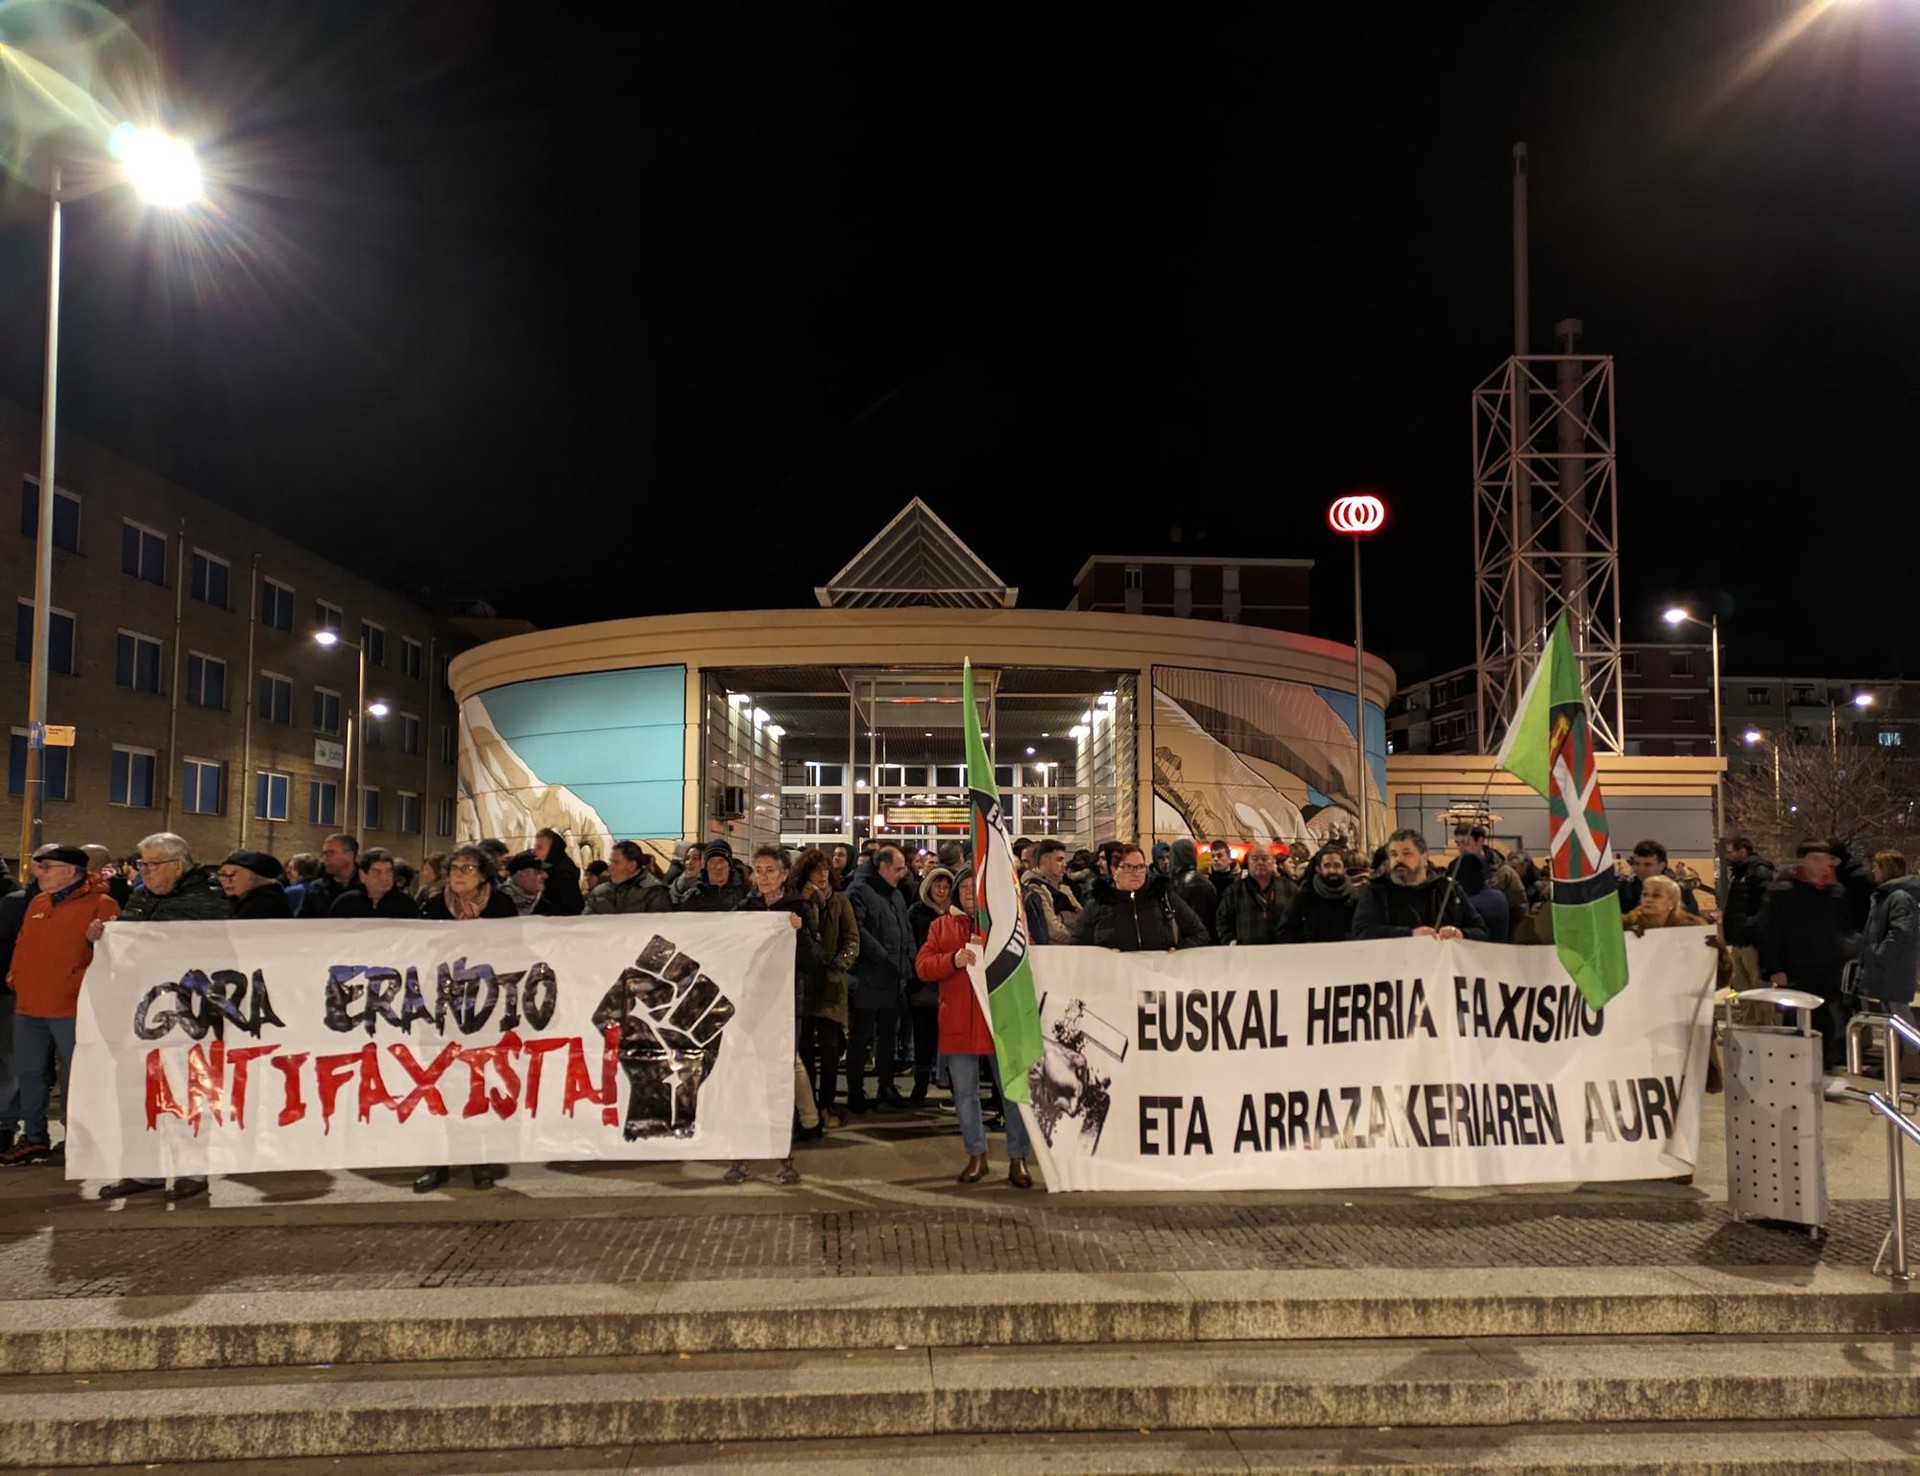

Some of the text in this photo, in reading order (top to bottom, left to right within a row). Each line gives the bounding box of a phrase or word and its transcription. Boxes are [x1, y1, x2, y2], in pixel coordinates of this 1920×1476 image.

[134, 957, 557, 1041] GORA ERANDIO
[1137, 976, 1605, 1053] EUSKAL HERRIA FAXISMO
[145, 1021, 621, 1138] ANTIFAXISTA!
[1138, 1095, 1214, 1156] ETA
[1232, 1083, 1565, 1154] ARRAZAKERIAREN
